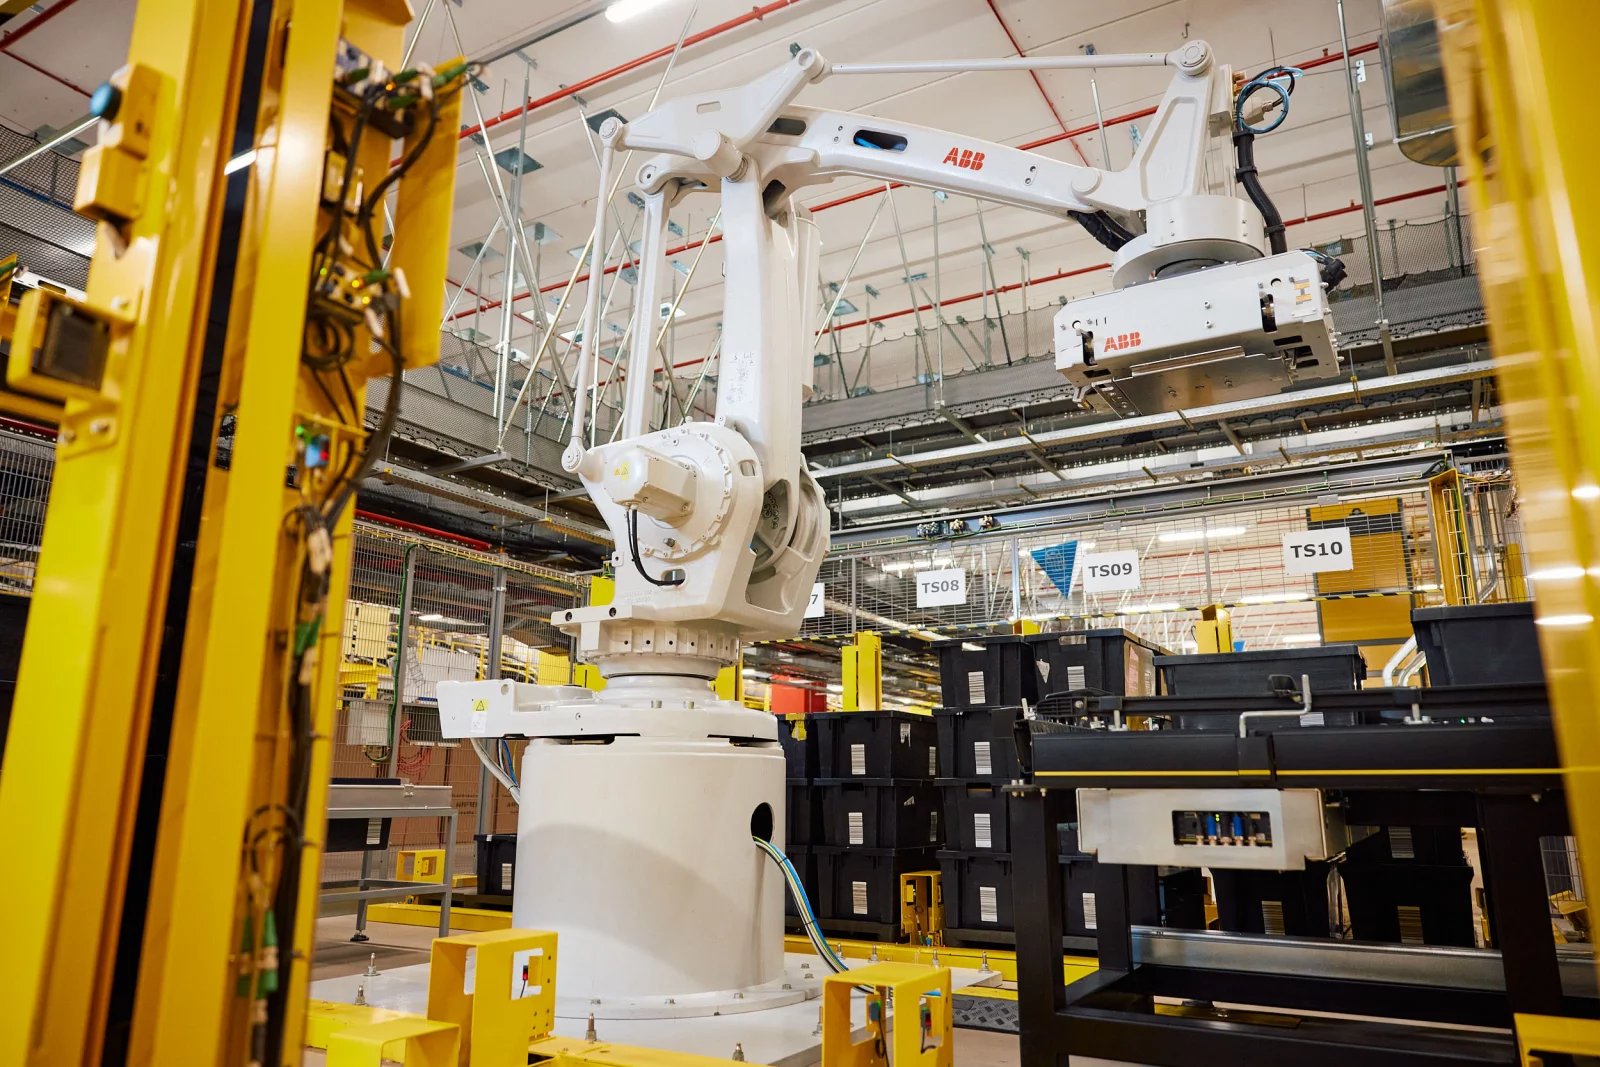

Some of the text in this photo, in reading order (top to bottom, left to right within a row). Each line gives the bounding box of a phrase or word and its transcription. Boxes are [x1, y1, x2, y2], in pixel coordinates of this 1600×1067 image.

[942, 147, 985, 170] ABB
[1103, 332, 1141, 352] ABB
[1290, 541, 1343, 558] TS10
[1088, 562, 1132, 578] TS09
[921, 579, 960, 594] TS08
